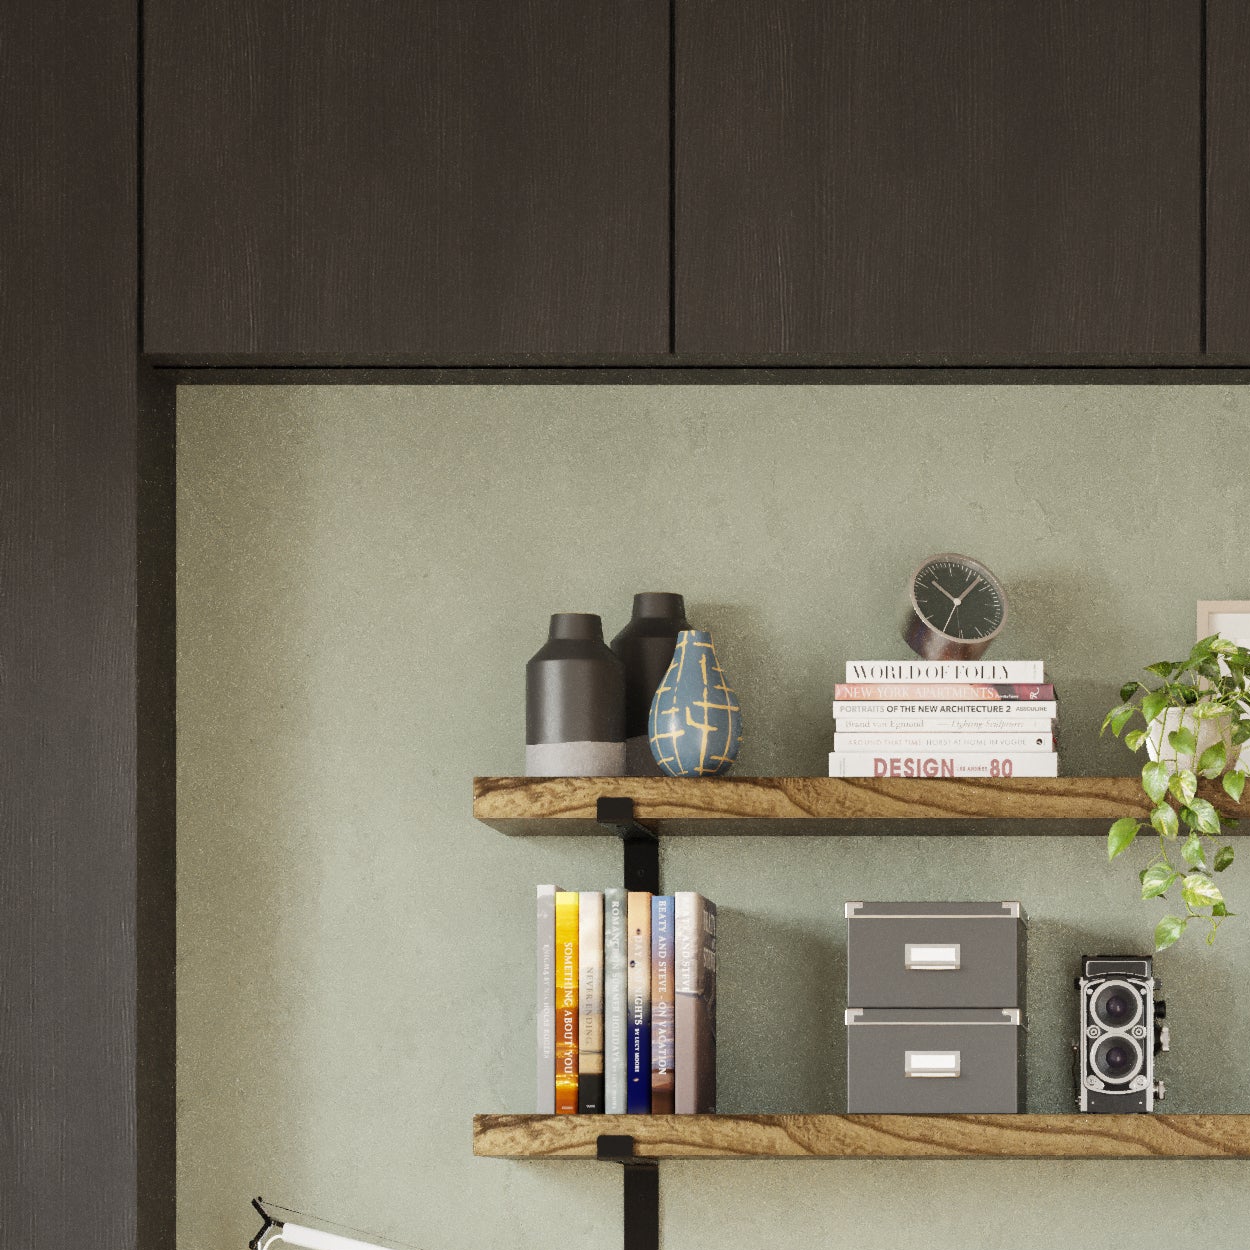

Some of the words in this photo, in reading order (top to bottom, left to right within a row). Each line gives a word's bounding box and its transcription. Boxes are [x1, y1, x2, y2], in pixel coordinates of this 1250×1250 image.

[853, 665, 921, 680] WORLD
[926, 665, 950, 680] OF
[955, 665, 1008, 680] FOLLY
[843, 687, 872, 698] NEW
[877, 687, 909, 698] YORK
[916, 687, 994, 698] APARTMENTS
[840, 705, 885, 713] PORTRAITS
[886, 705, 898, 713] OF
[900, 705, 915, 713] THE
[918, 705, 938, 713] NEW
[939, 705, 1004, 713] ARCHITECTURE
[1005, 705, 1011, 713] 2
[874, 758, 954, 777] DESIGN
[989, 758, 1013, 777] 80
[658, 900, 667, 933] BEATY
[658, 935, 667, 958] AND
[563, 942, 573, 1007] SOMETHING
[585, 967, 594, 1000] NEVER
[658, 961, 667, 992] STEVE
[634, 987, 642, 1025] NIGHTS
[658, 1002, 667, 1017] ON
[563, 1010, 573, 1045] ABOUT
[585, 1003, 594, 1045] ENDING
[563, 1049, 573, 1074] YOU
[658, 1021, 667, 1075] VACATION
